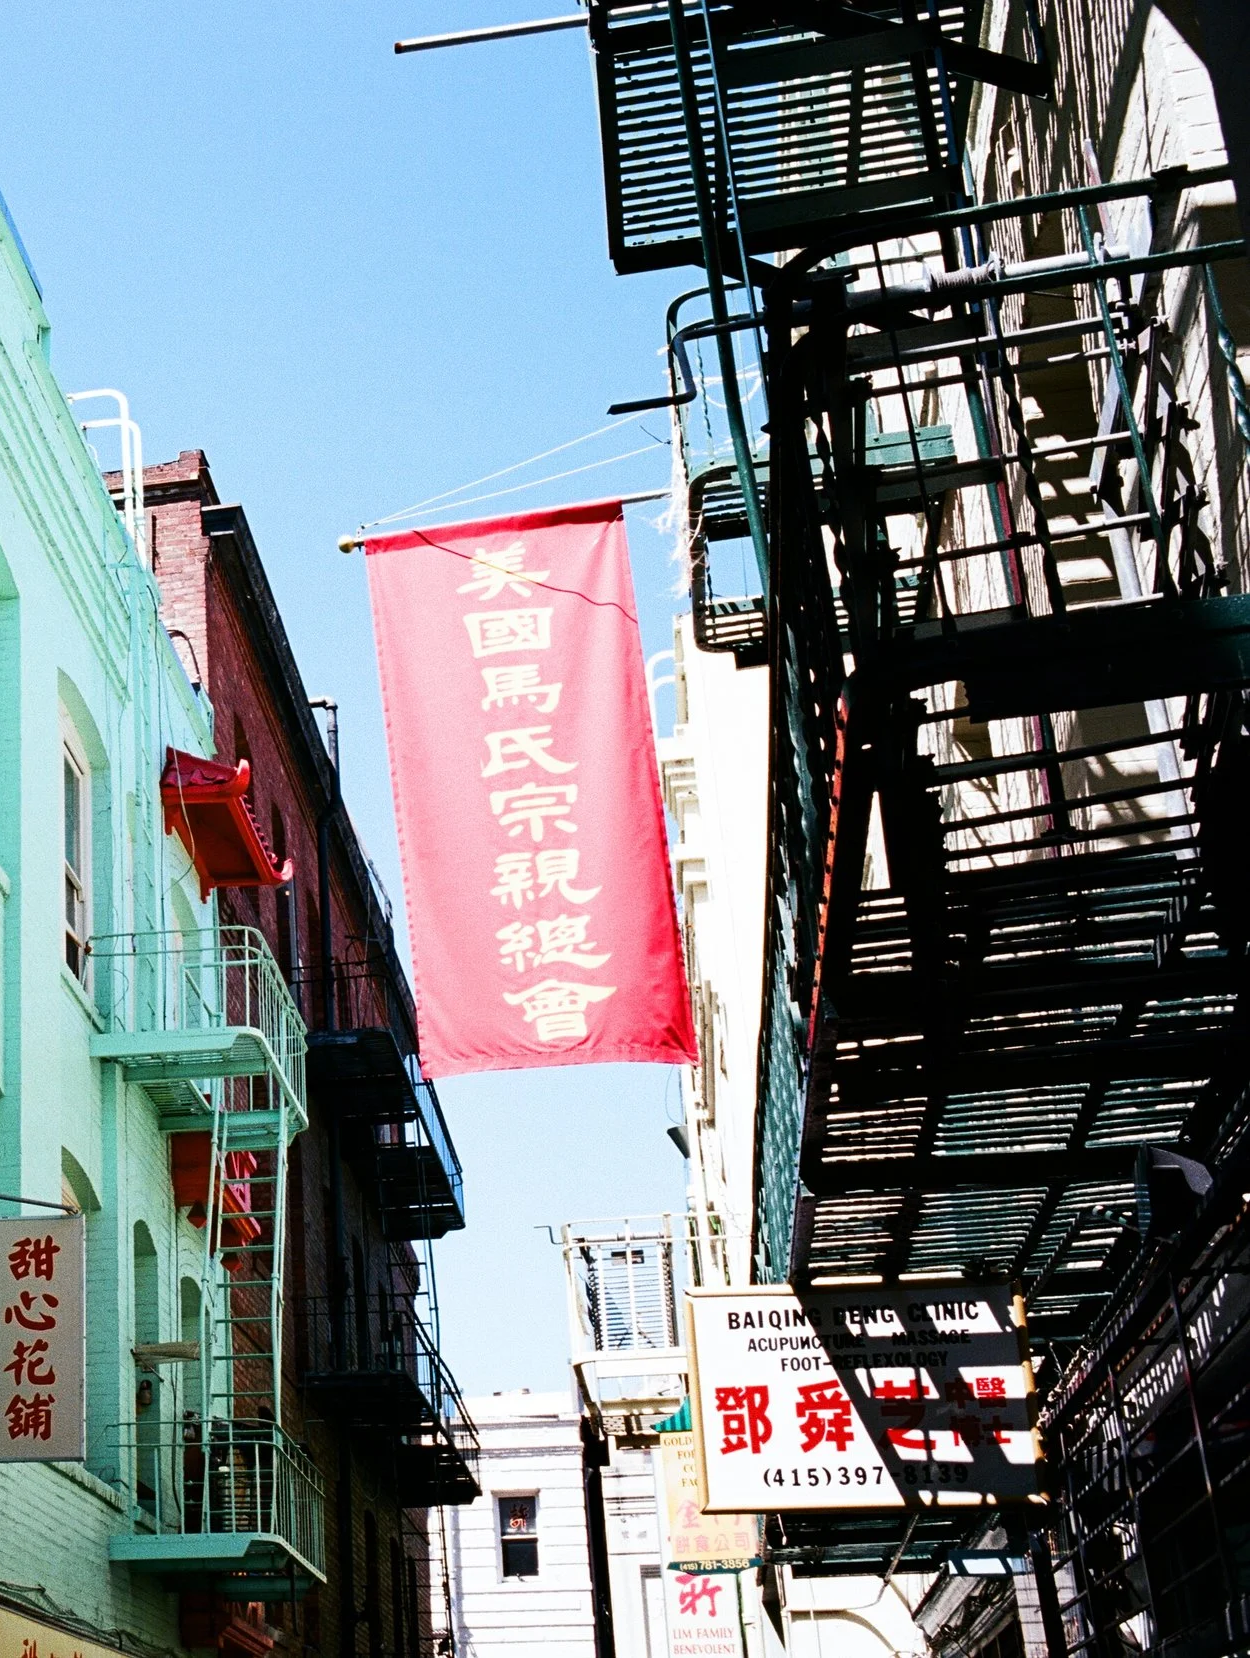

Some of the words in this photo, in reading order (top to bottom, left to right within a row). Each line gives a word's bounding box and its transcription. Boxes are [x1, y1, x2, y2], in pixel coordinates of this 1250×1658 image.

[457, 540, 617, 1042] 美國馬氏宗親總會
[727, 1307, 822, 1331] BAIQING
[834, 1304, 894, 1326] DENG
[908, 1301, 980, 1323] CLINIC
[747, 1332, 866, 1352] ACUPUNCTURE
[892, 1329, 972, 1347] MASSAGE
[781, 1350, 949, 1373] FOOT-REFLEXOLOGY
[945, 1376, 1007, 1409] 中醫
[715, 1377, 937, 1456] 鄧舜芝
[663, 1436, 695, 1447] GOLD
[763, 1463, 969, 1489] (415)397-8139
[672, 1627, 693, 1640] LIM
[696, 1626, 735, 1639] FAMILY
[673, 1643, 736, 1655] BENEVOLENT
